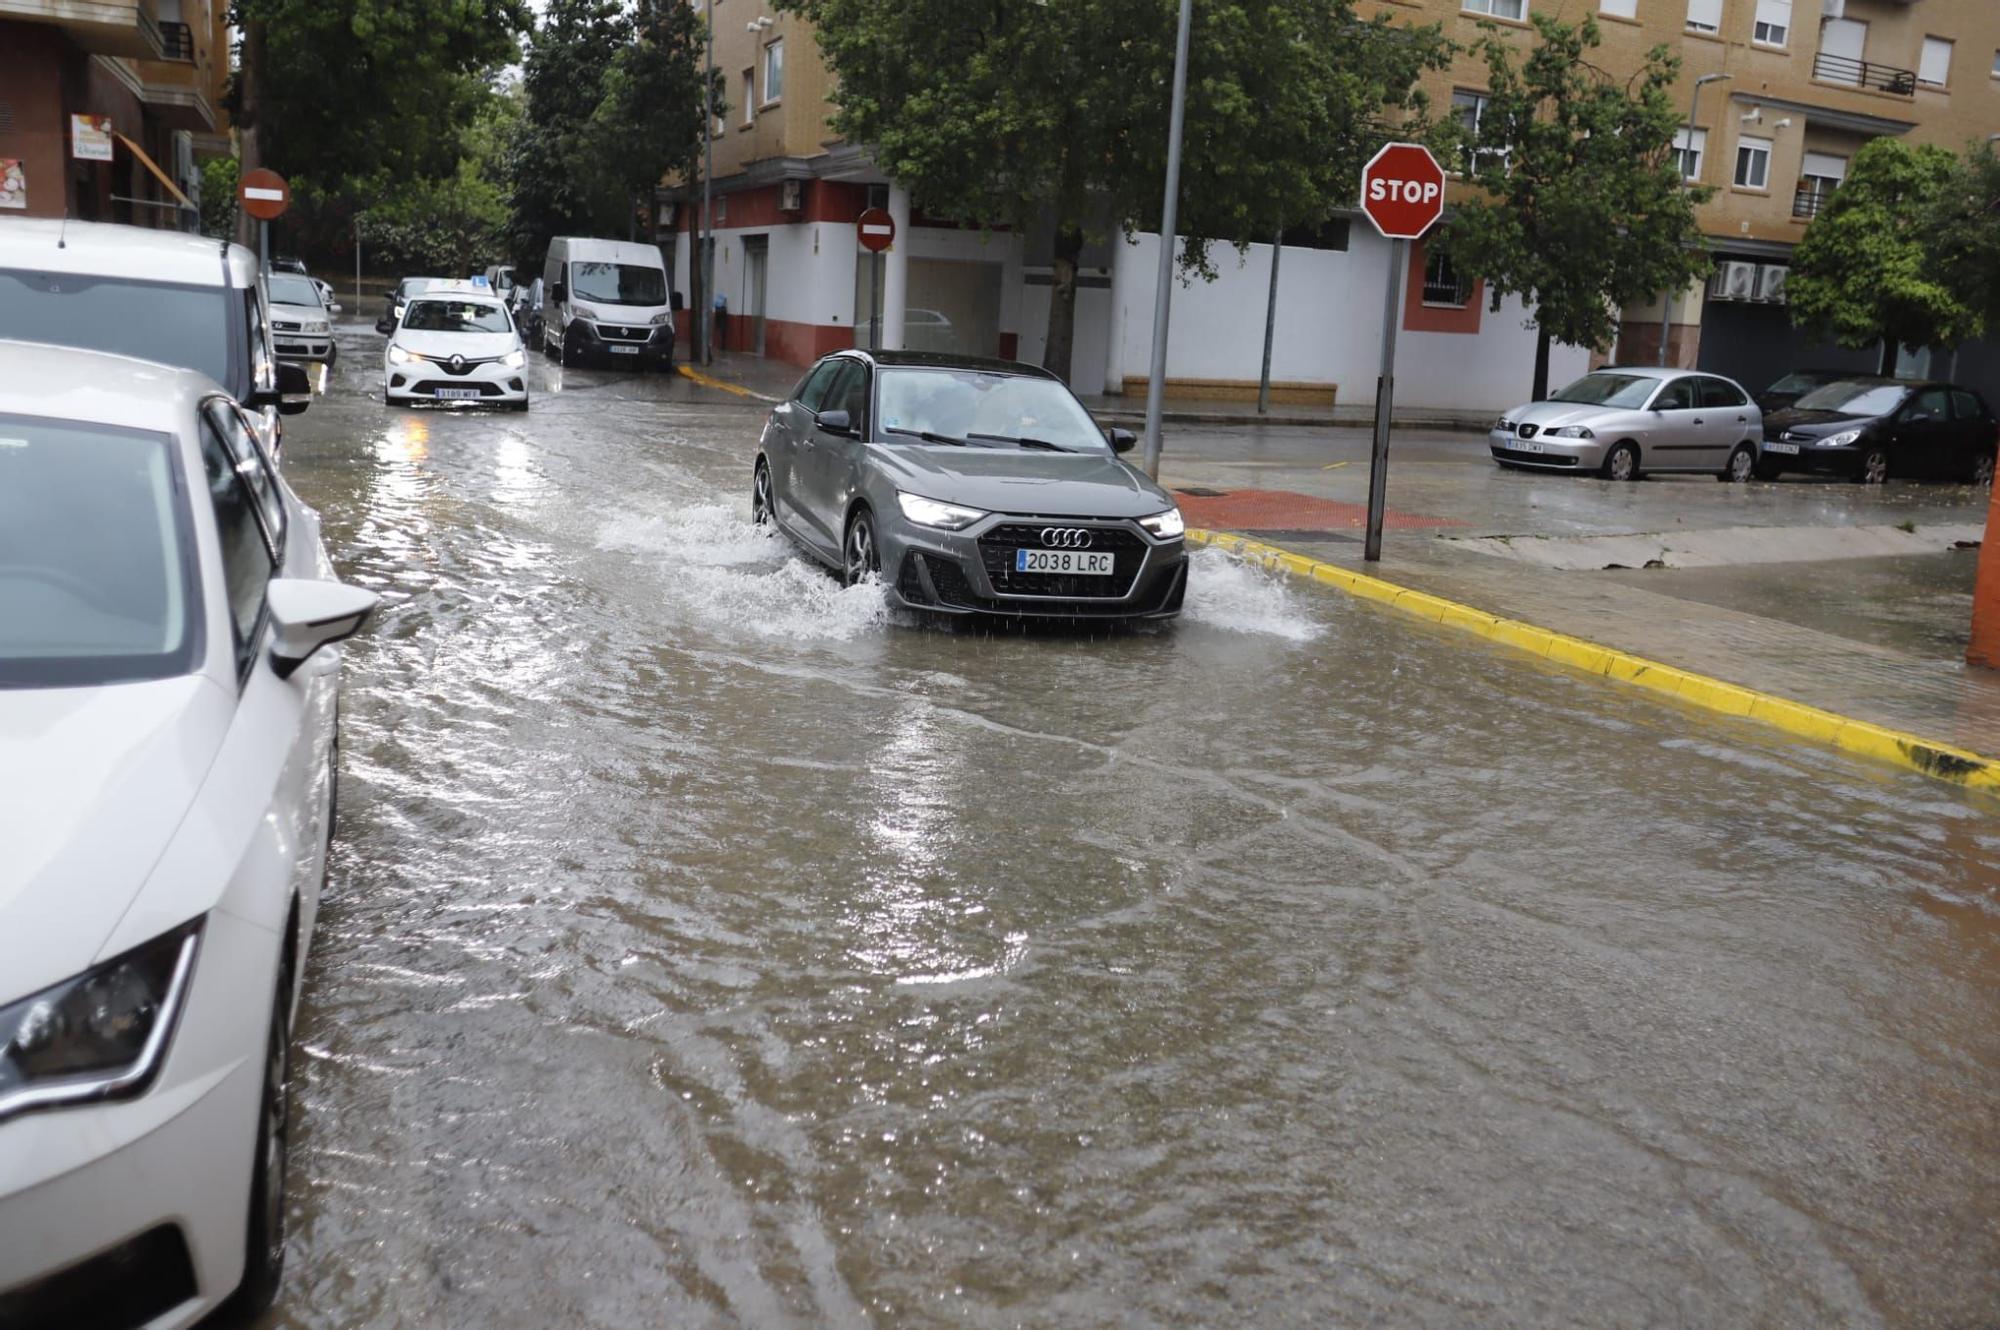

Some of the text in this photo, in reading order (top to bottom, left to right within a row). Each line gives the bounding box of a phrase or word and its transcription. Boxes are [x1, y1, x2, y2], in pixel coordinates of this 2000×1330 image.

[1369, 178, 1439, 204] STOP
[1027, 553, 1109, 572] 2038 LRC
